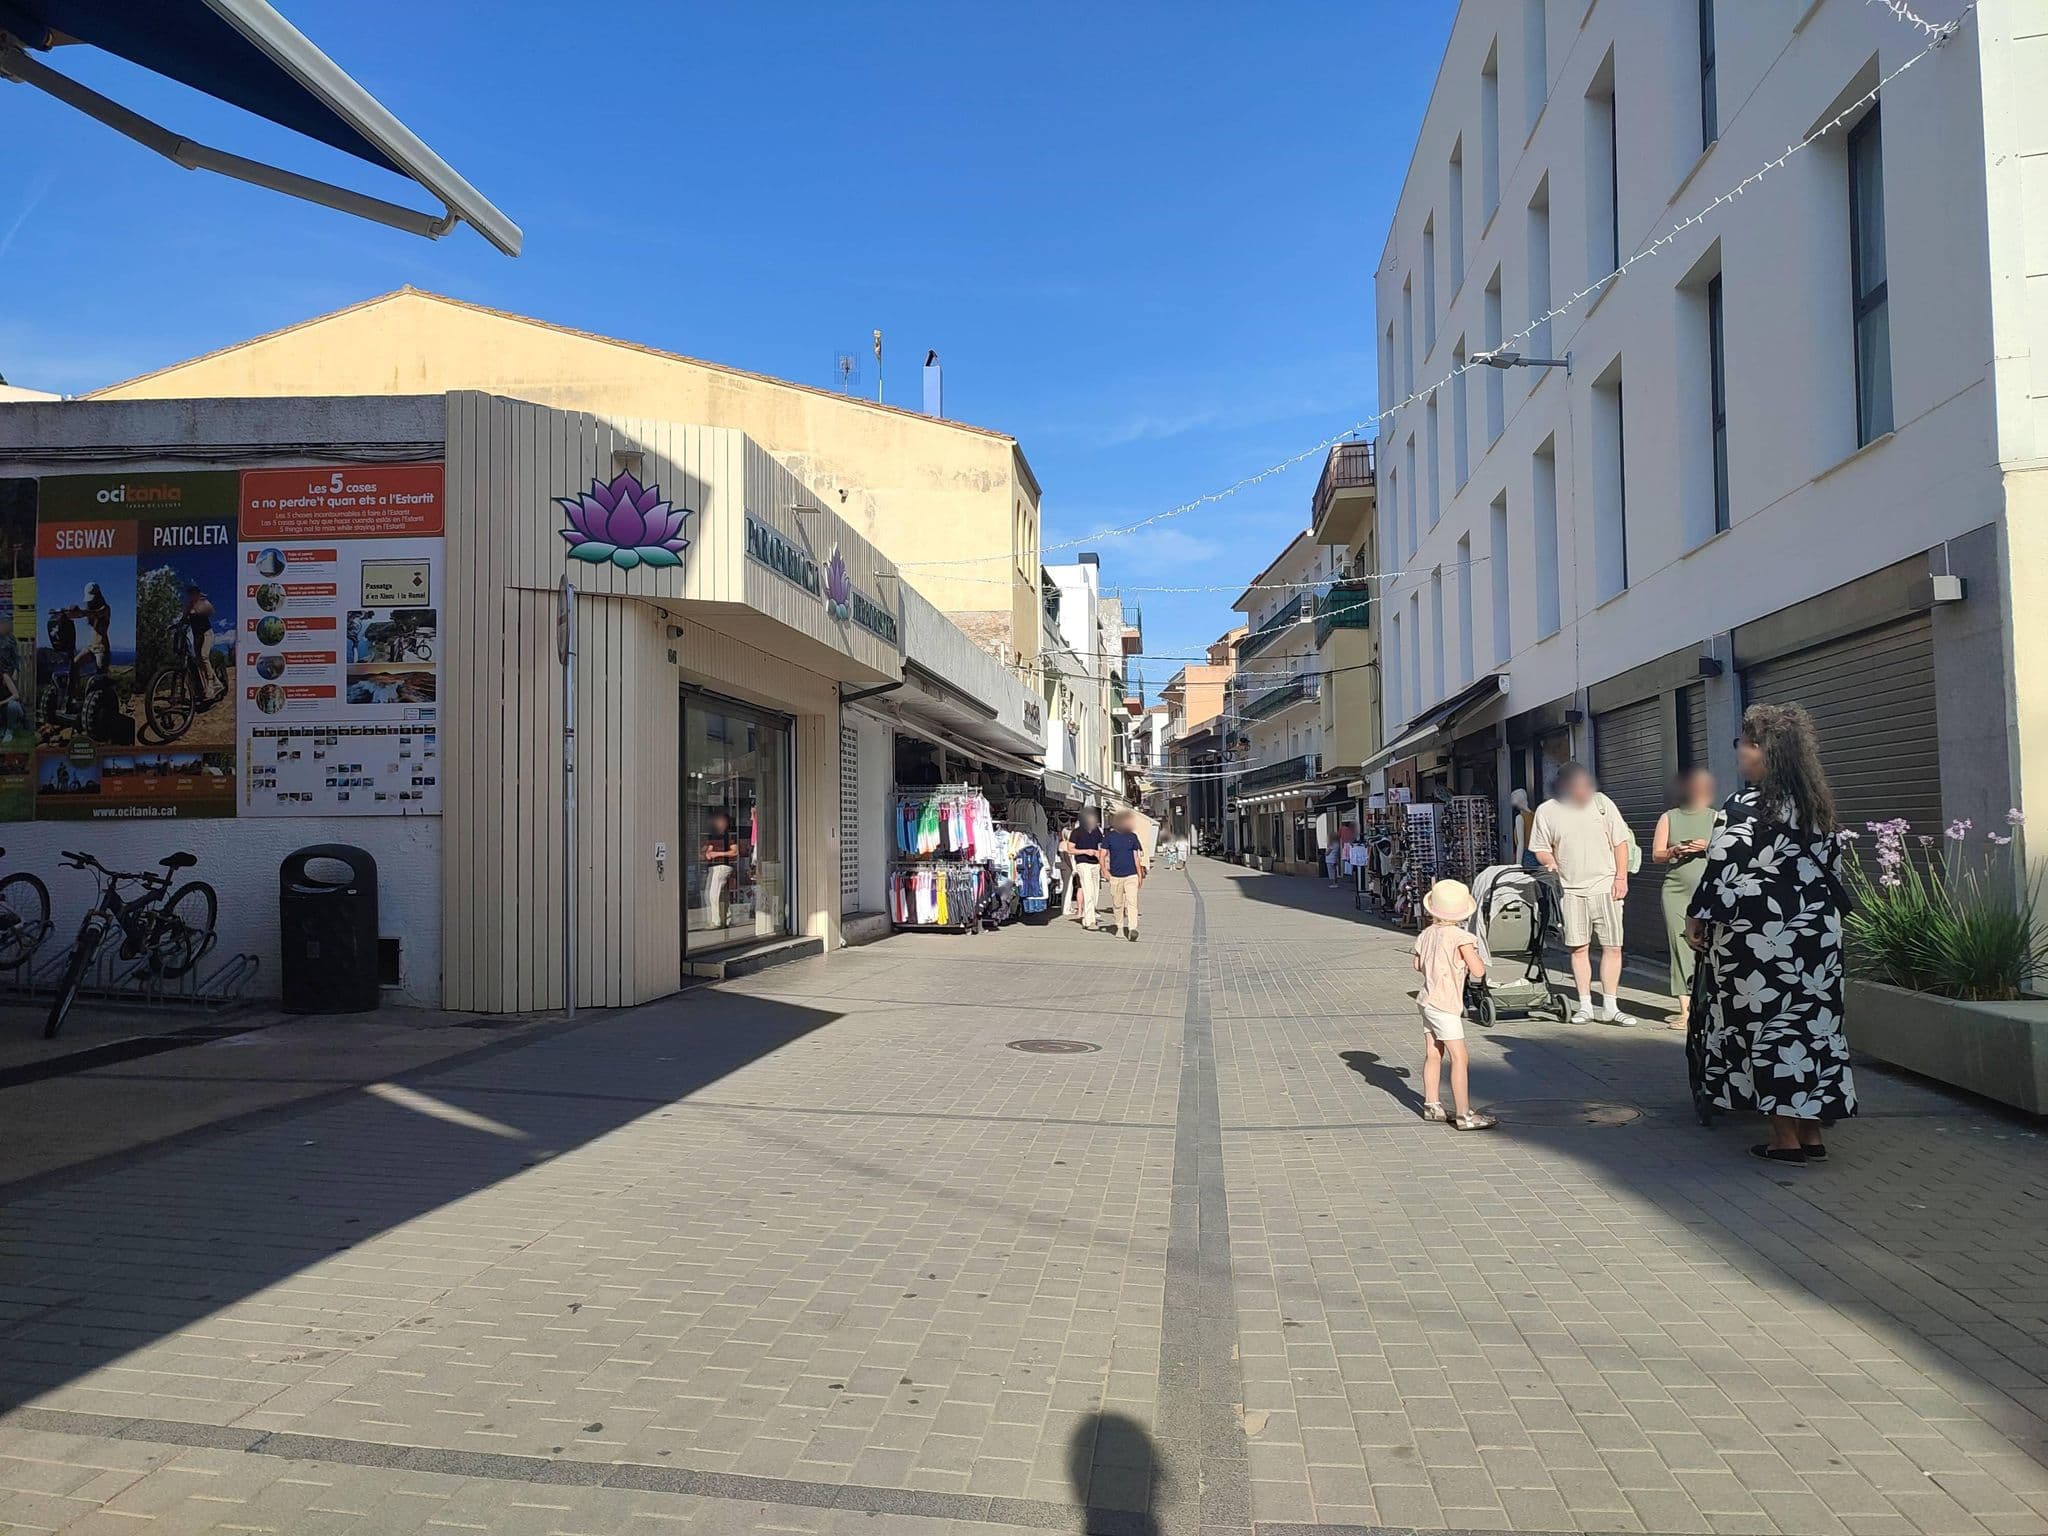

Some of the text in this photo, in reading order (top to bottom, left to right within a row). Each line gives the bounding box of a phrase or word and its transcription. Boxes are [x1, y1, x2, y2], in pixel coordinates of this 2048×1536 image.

[96, 483, 181, 503] ocitania
[308, 473, 377, 494] Les 5 coses
[251, 492, 434, 510] a no perdre't quan ets a l'Estartit
[56, 529, 115, 550] SEGWAY
[153, 525, 229, 547] PATICLETA
[248, 655, 254, 663] 4
[249, 689, 254, 697] 5
[92, 806, 177, 818] www.ocitania.cat
